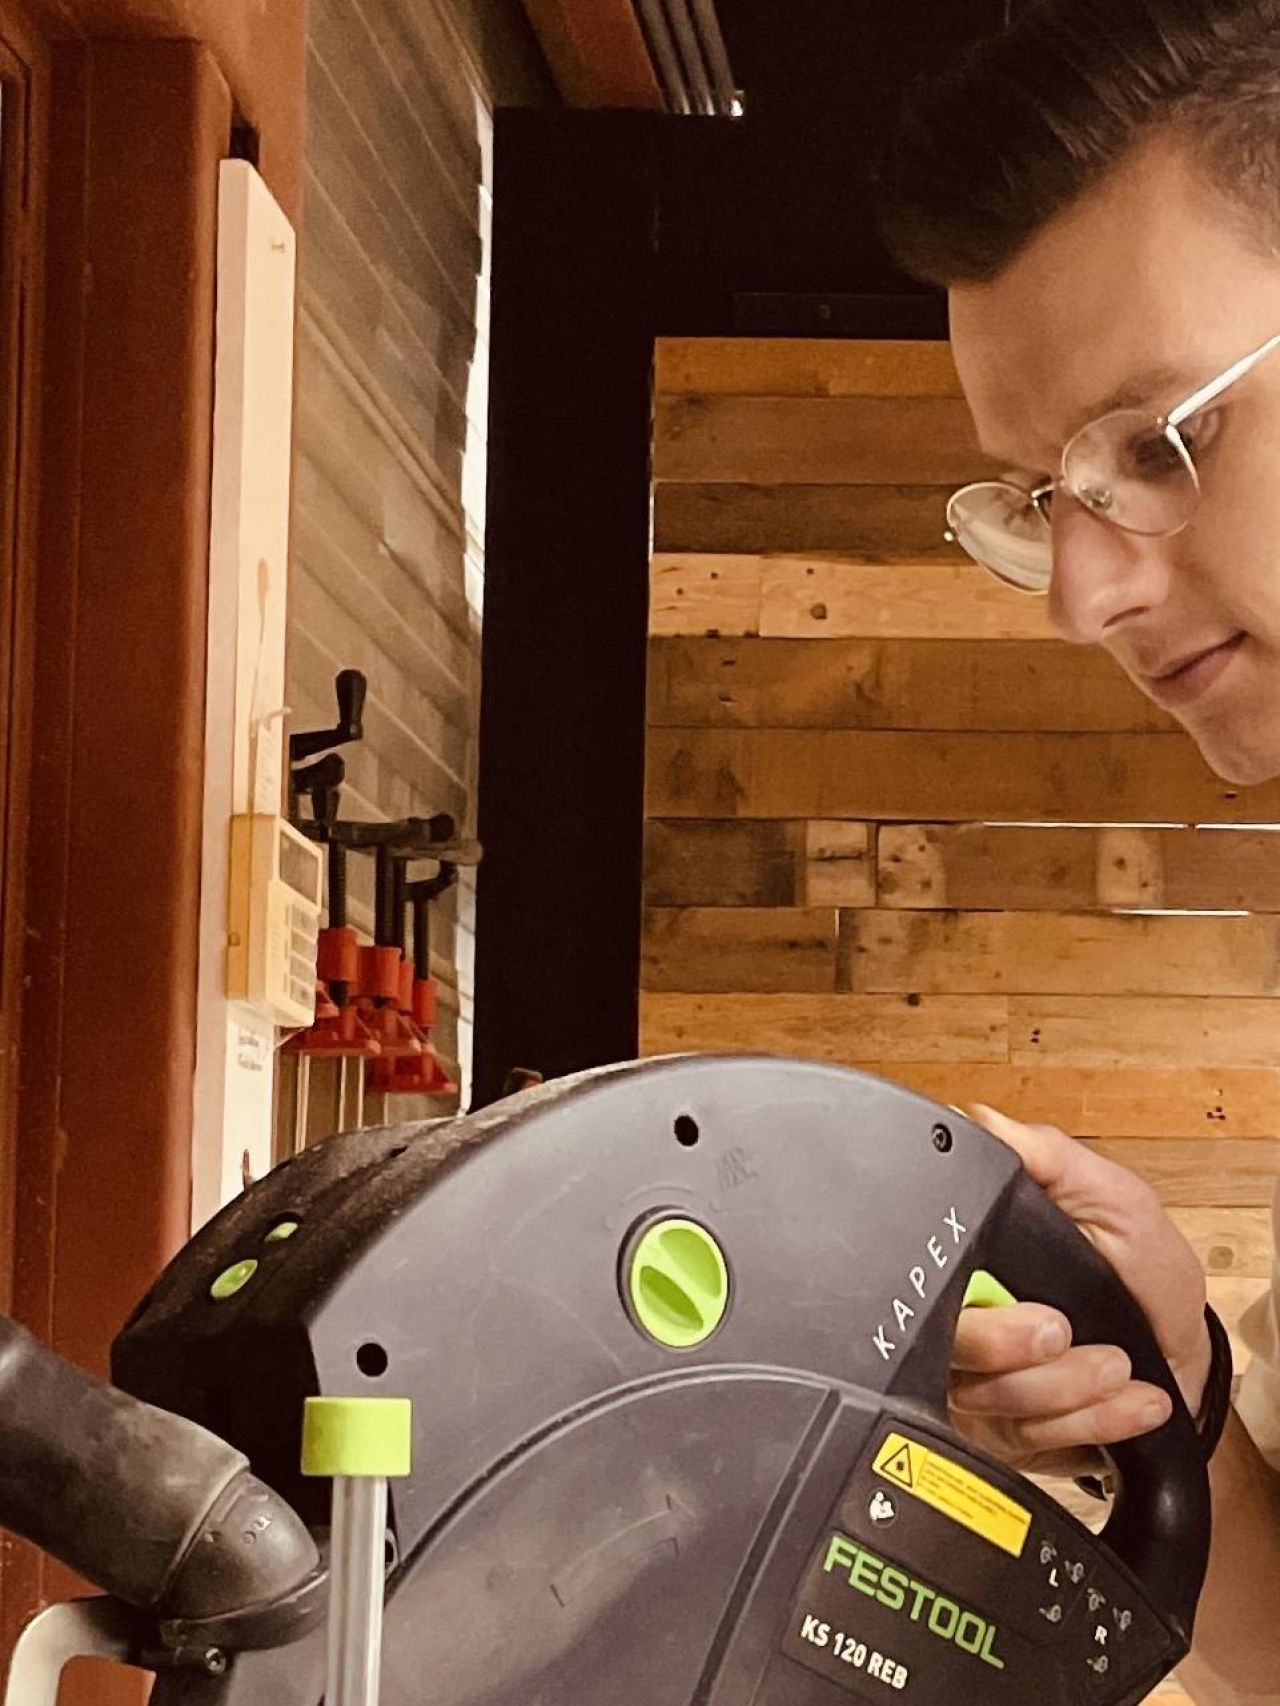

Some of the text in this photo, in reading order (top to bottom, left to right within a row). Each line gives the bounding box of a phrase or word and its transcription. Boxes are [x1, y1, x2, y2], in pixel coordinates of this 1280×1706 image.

[872, 1206, 967, 1361] KAPEX
[801, 1615, 908, 1690] KS 120 REB
[823, 1535, 1005, 1670] FESTOOL
